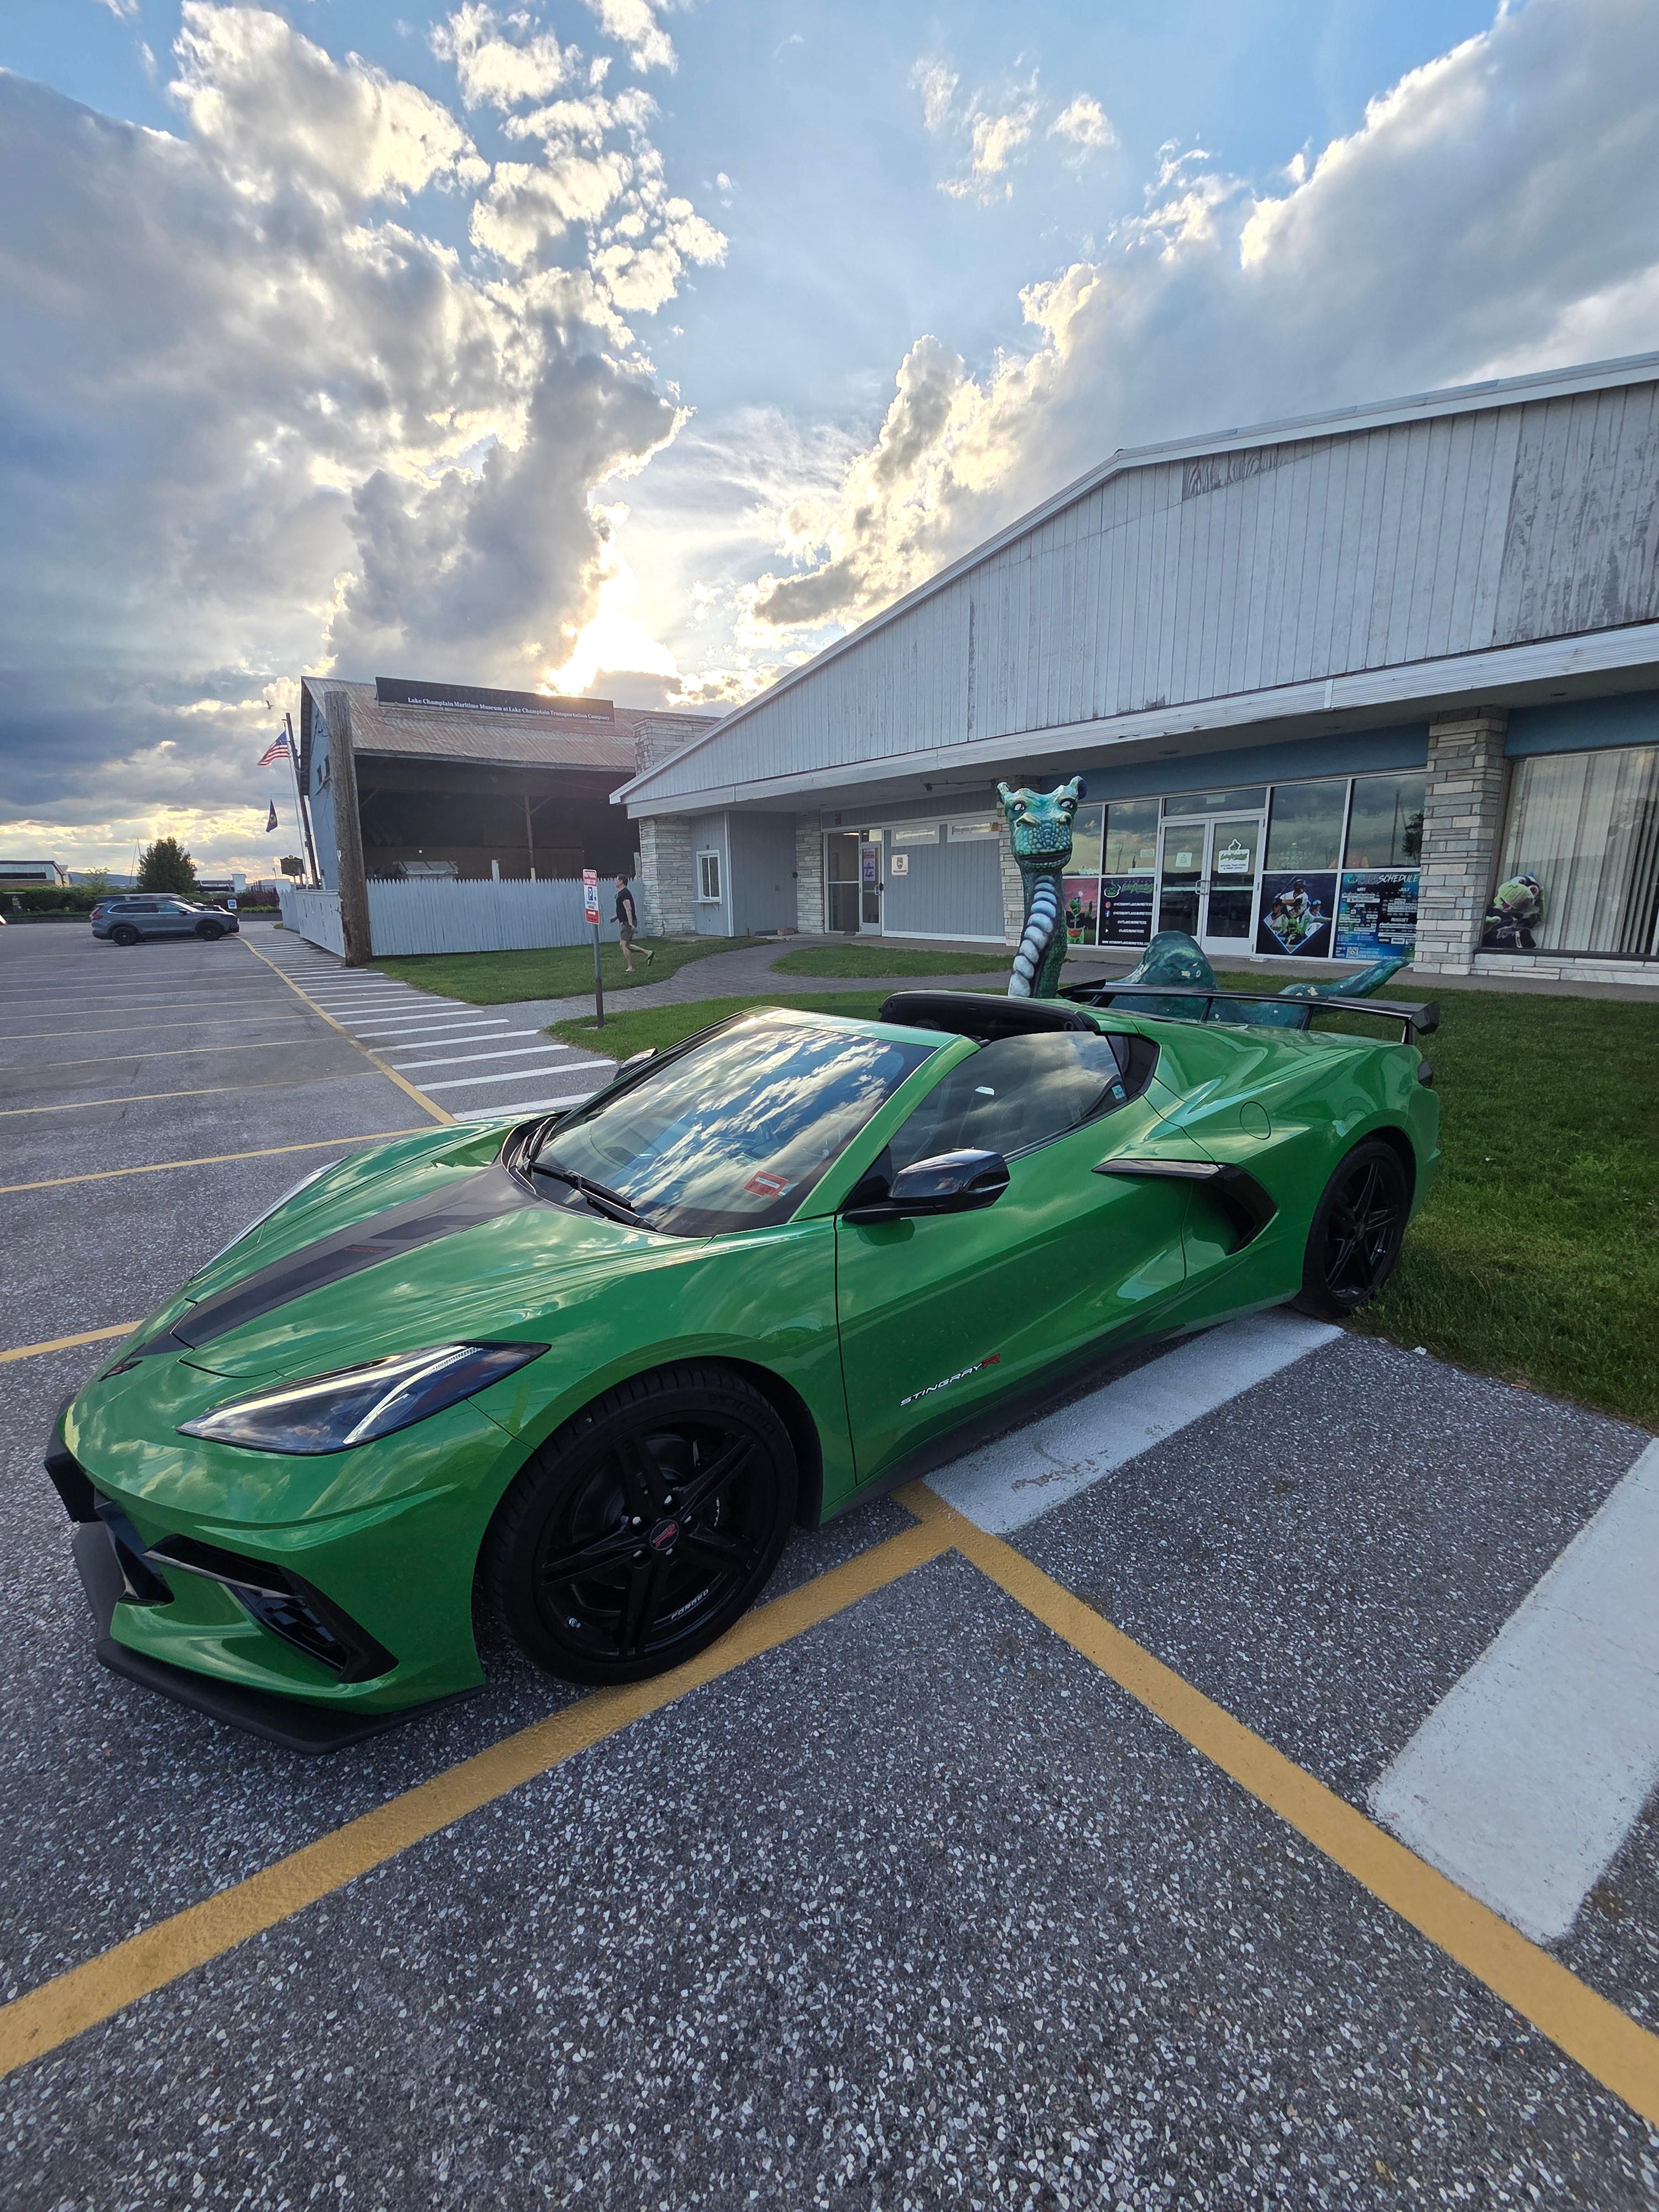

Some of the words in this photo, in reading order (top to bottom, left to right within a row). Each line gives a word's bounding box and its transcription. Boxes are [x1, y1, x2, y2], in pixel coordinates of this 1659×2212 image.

[422, 698, 453, 707] Champlain
[551, 710, 587, 718] Transportation
[1377, 874, 1420, 884] SCHEDULE
[900, 1363, 982, 1406] STINGRAY
[671, 1588, 709, 1620] FORGED
